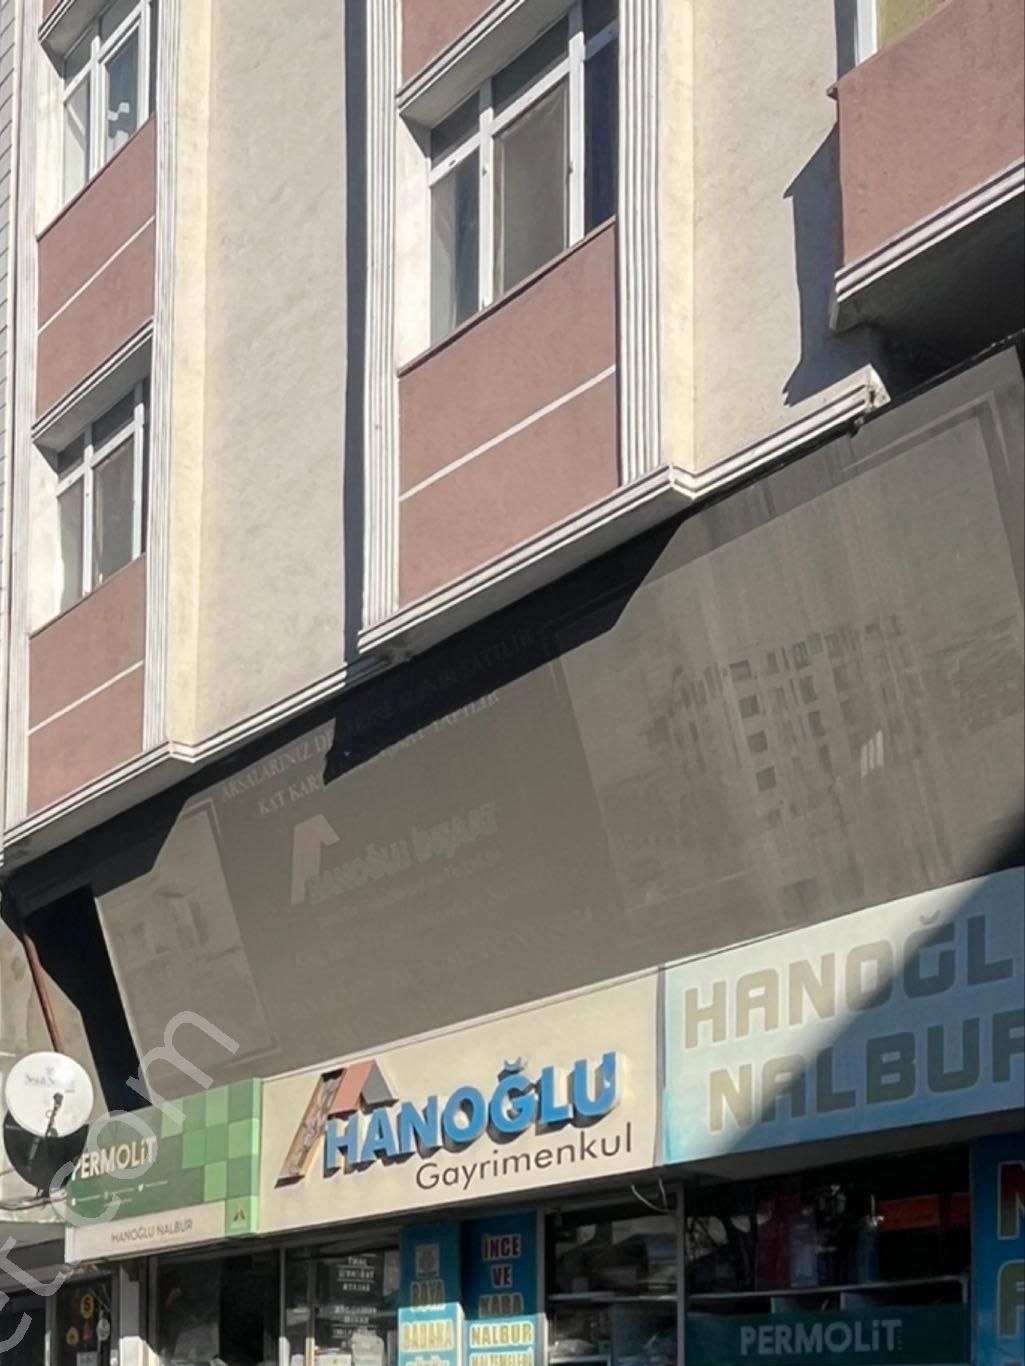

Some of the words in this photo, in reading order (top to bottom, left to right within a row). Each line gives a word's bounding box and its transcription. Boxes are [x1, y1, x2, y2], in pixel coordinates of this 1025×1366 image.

[324, 1050, 619, 1171] HANOĞLU
[416, 1122, 633, 1191] Gayrimenkul
[157, 1219, 193, 1236] NALBUR
[491, 1265, 512, 1288] VE
[470, 1322, 534, 1348] NALBUR
